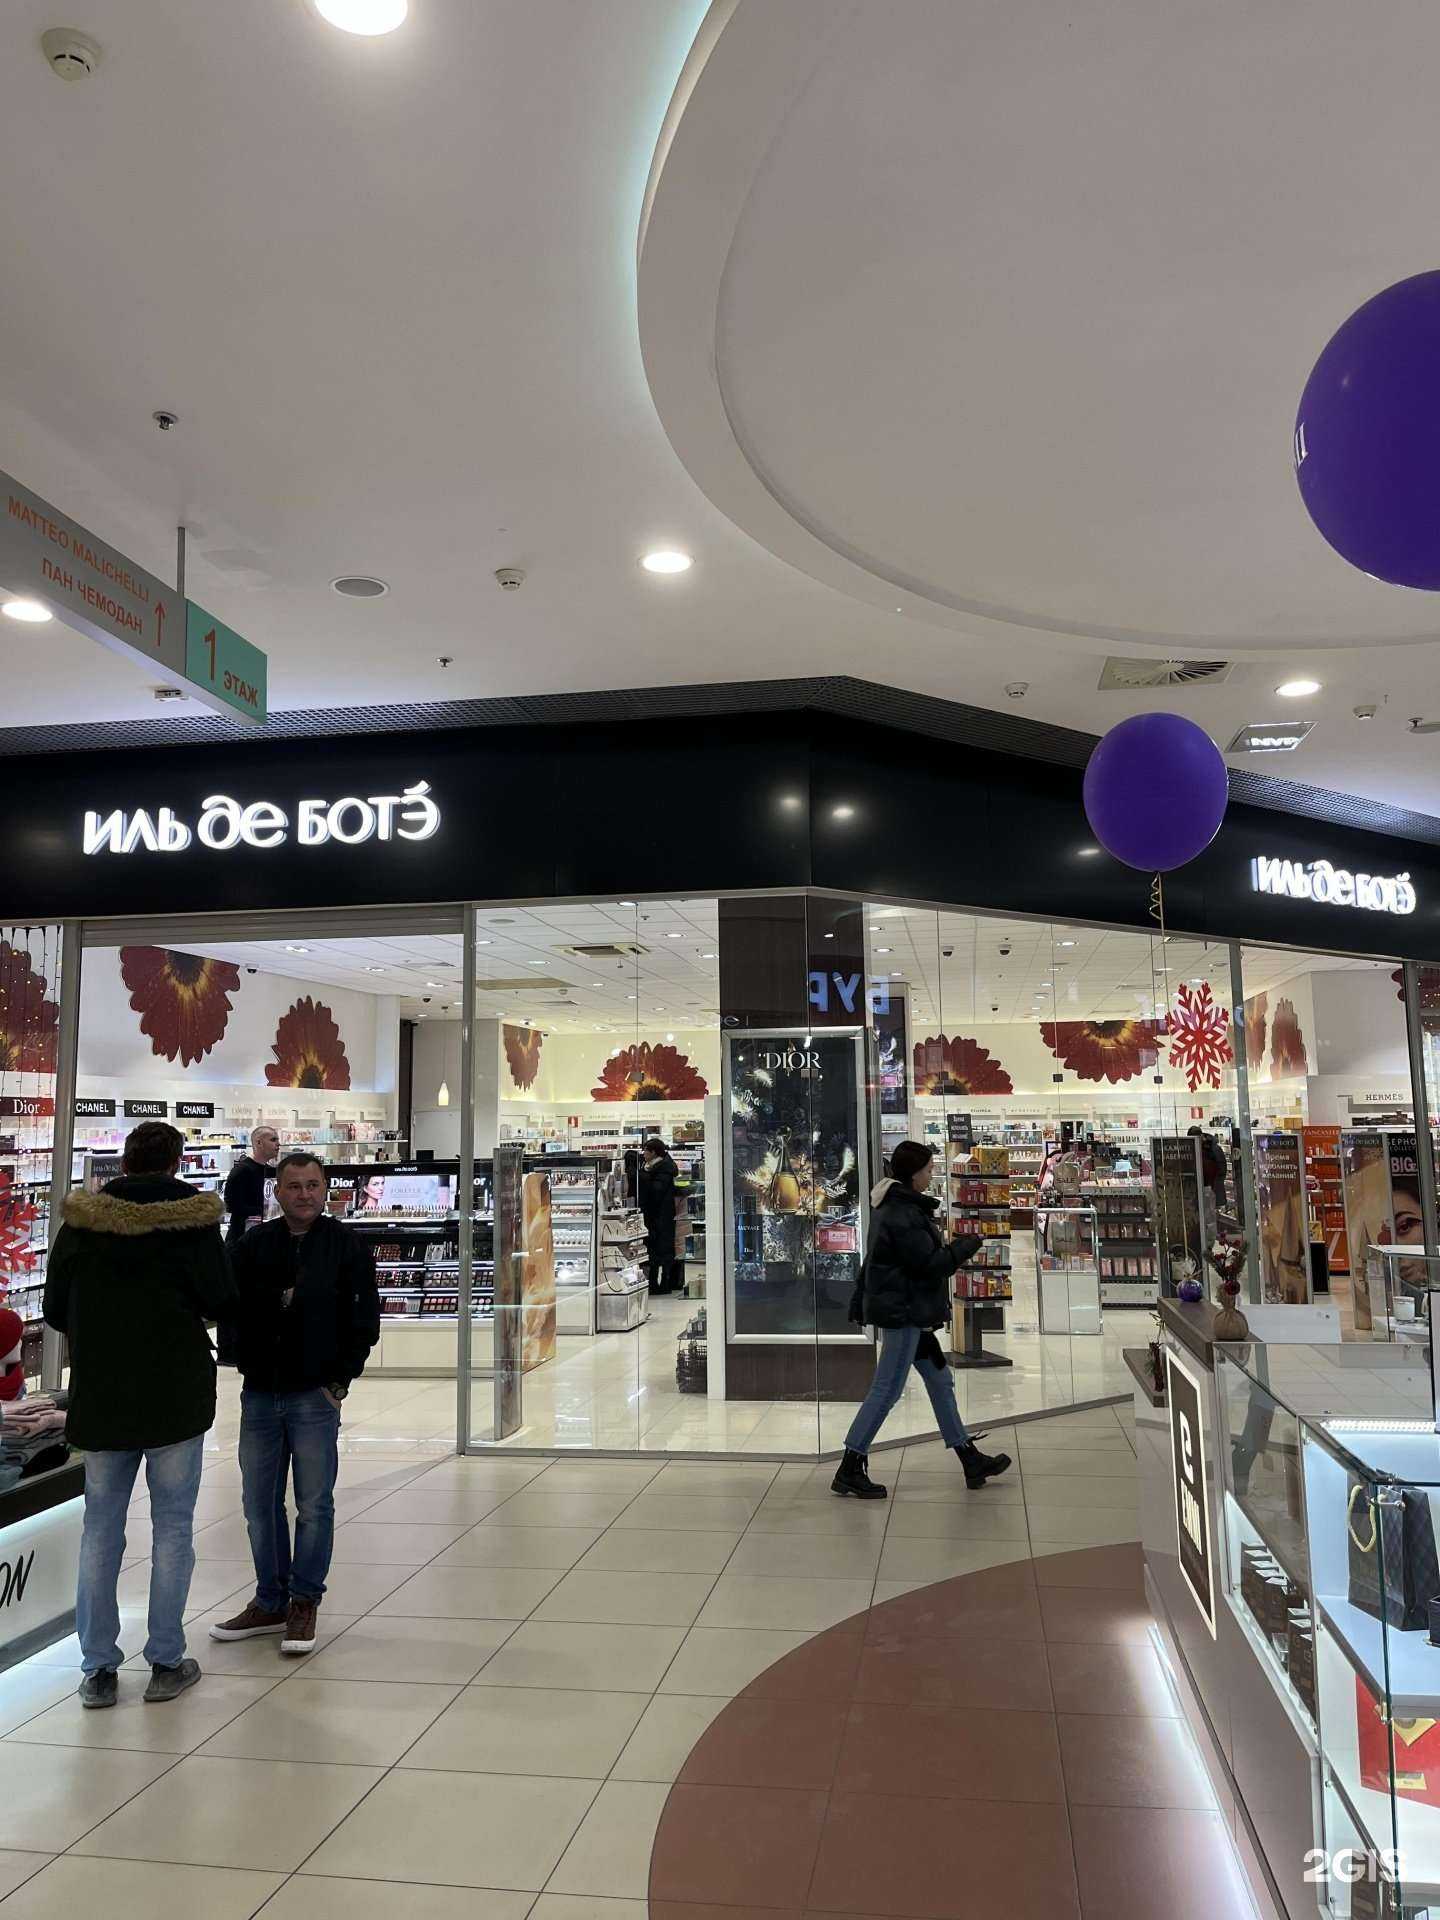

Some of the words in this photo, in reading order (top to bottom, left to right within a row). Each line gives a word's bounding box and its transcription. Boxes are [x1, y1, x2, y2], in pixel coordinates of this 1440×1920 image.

[8, 496, 69, 548] MATTEO
[73, 539, 149, 602] MALICHELLI
[42, 558, 73, 591] ПАН
[78, 583, 143, 635] ЧЕМОДАН
[205, 629, 216, 681] 1
[223, 670, 259, 708] ЭТАЖ
[83, 807, 192, 855] ИЛЬ
[766, 1052, 822, 1070] DIOR
[13, 1099, 41, 1114] Dior
[76, 1102, 109, 1113] CHANEL
[132, 1105, 162, 1114] CHANEL
[182, 1105, 210, 1115] CHANEL
[330, 1177, 354, 1188] Dior
